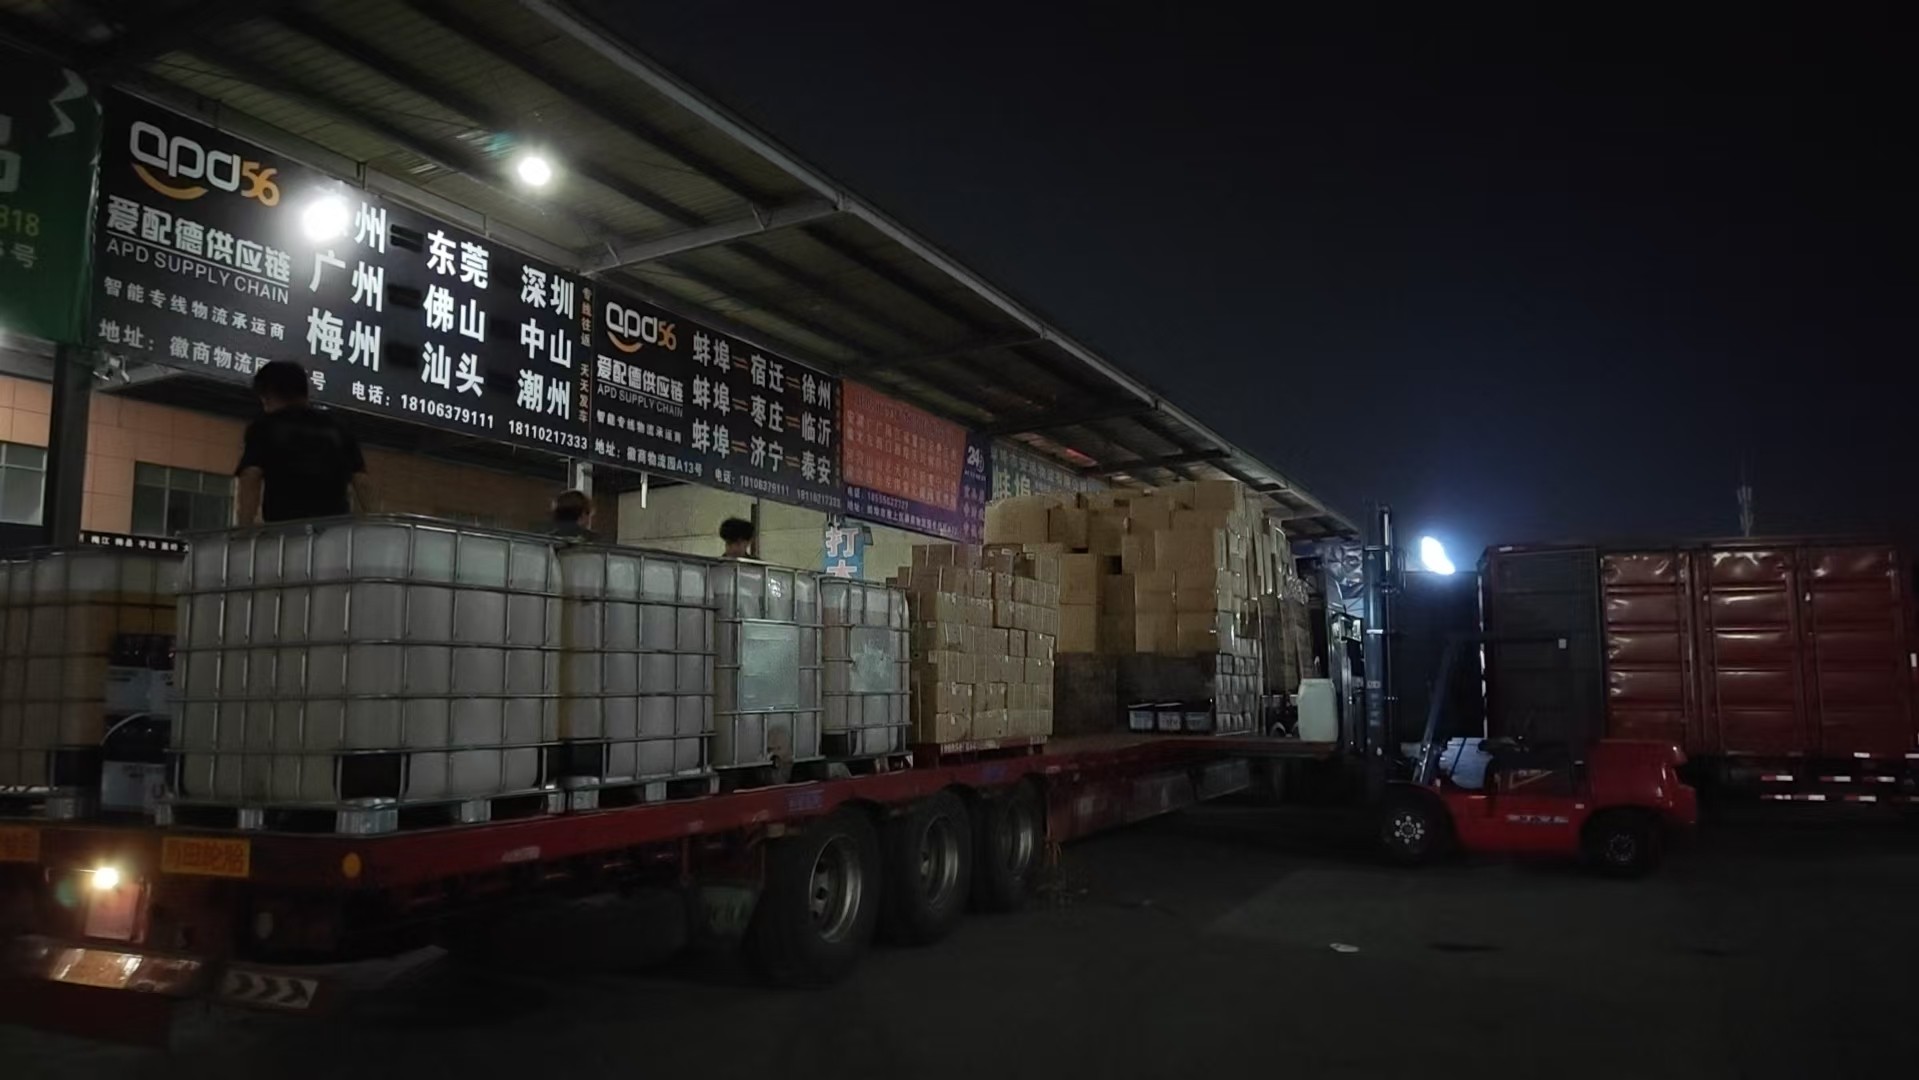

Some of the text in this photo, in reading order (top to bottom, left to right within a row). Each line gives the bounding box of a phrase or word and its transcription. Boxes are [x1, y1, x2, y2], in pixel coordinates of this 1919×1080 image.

[106, 237, 289, 304] APD SUPPLY CHAIN
[107, 194, 291, 284] 爱配德供应链
[427, 229, 489, 289] 东莞
[520, 264, 575, 320] 深圳
[103, 276, 286, 341] 智能专线物流承运商
[309, 249, 572, 369] 广州 佛山 中山
[306, 306, 571, 421] 梅州 汕头 潮州
[596, 353, 684, 404] 爱配德供应链
[692, 329, 832, 412] 蚌埠 宿迁 徐州
[508, 419, 588, 450] 18110217333
[596, 383, 683, 419] APD SUPPLY CHAIN
[692, 373, 731, 418] 蚌埠
[750, 394, 785, 434] 枣庄
[801, 410, 832, 448] 临沂
[691, 418, 832, 486] 蚌埠 济宁 泰安
